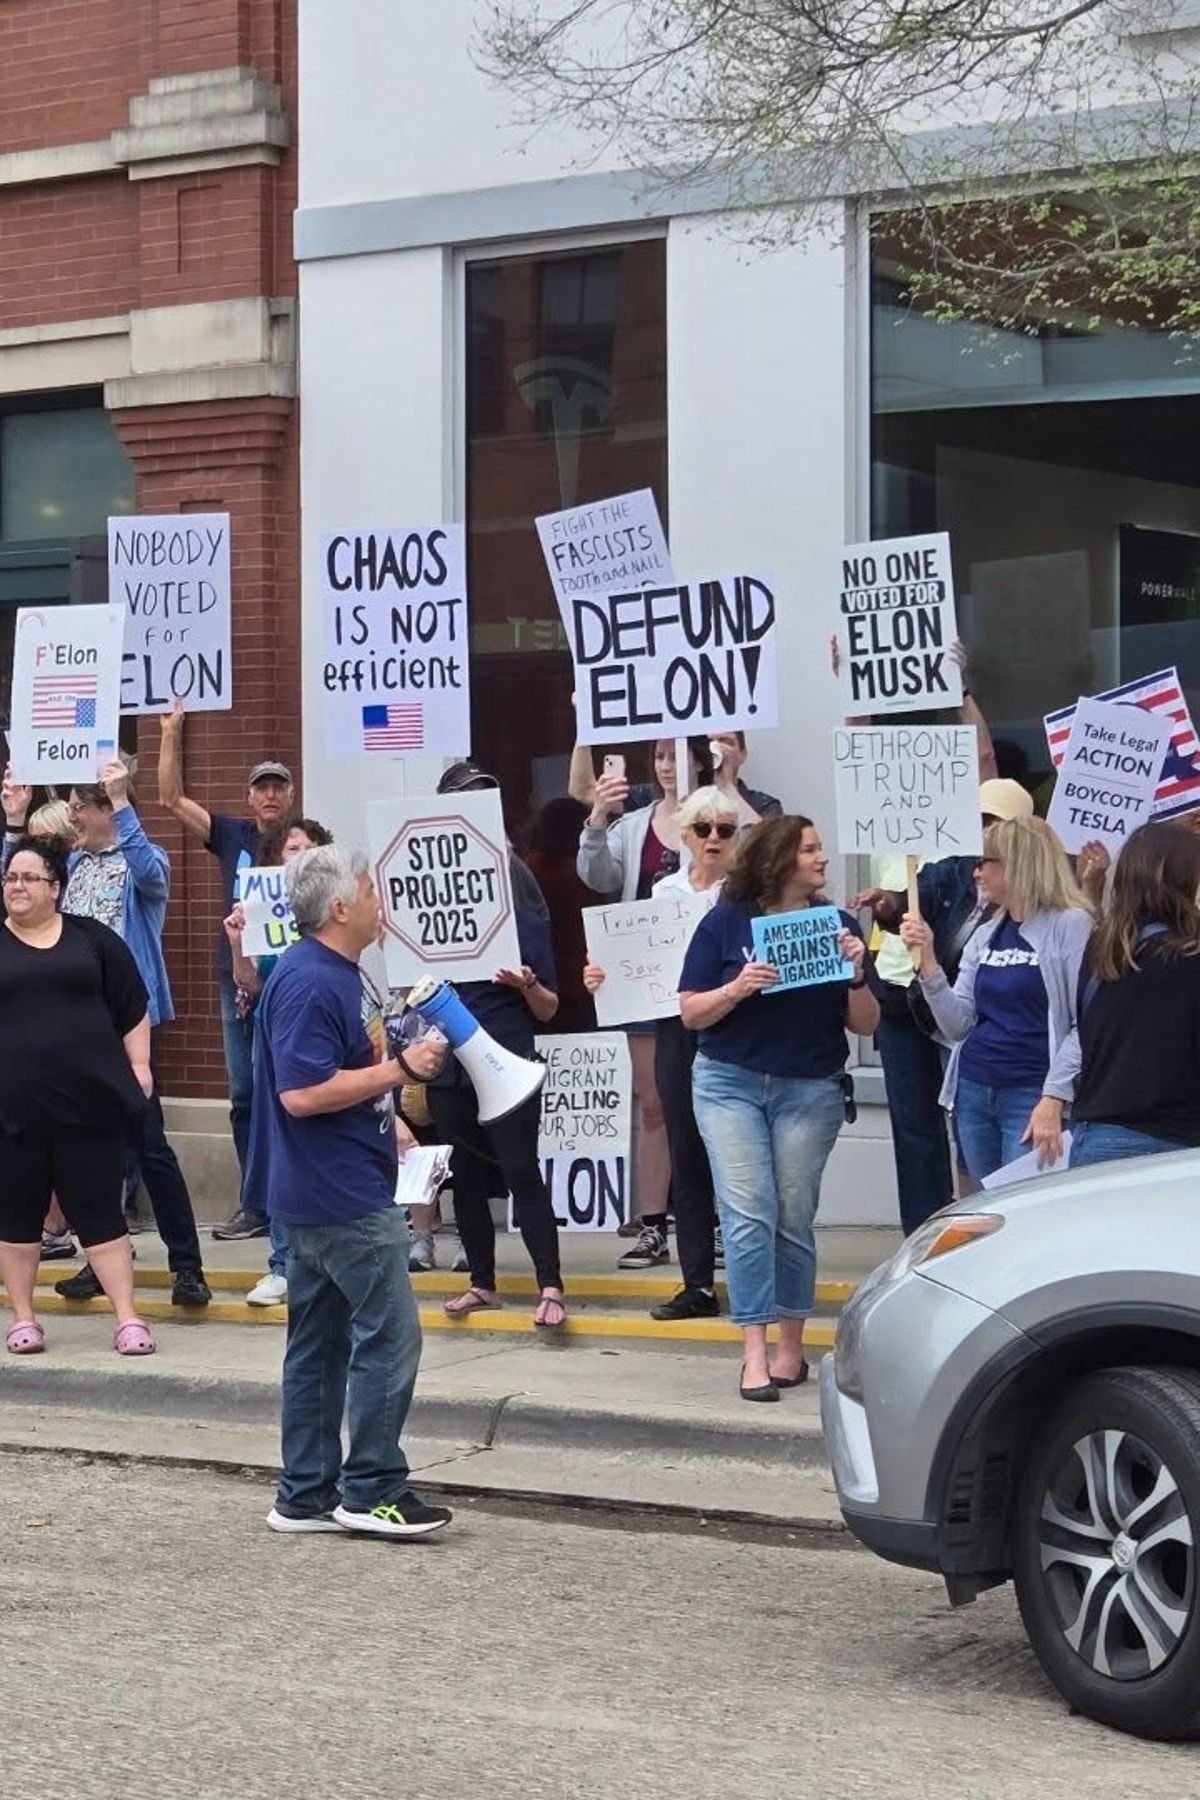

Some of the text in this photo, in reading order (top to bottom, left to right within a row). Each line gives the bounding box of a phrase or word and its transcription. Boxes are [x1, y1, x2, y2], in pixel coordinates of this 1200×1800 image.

[551, 501, 631, 540] FIGHT THE
[114, 528, 224, 567] NOBODY
[326, 529, 448, 592] CHAOS
[551, 524, 653, 572] FASCISTS
[842, 548, 939, 589] NO ONE
[124, 581, 218, 618] VOTED
[845, 583, 940, 613] VOTED FOR
[335, 598, 462, 645] IS NOT
[572, 576, 775, 665] DEFUND
[848, 606, 943, 657] ELON
[120, 649, 223, 709] ELON
[323, 649, 462, 692] efficient
[590, 645, 761, 729] ELON!
[850, 652, 949, 701] MUSK
[37, 739, 90, 761] Felon
[835, 730, 970, 760] DETHRONE
[1084, 723, 1159, 753] Take Legal
[842, 761, 969, 794] TRUMP
[1074, 746, 1154, 777] ACTION
[880, 794, 933, 810] AND
[1064, 782, 1144, 813] BOYCOTT
[855, 816, 961, 848] MUSK
[1069, 807, 1126, 836] TESLA
[408, 833, 468, 871] STOP
[389, 868, 496, 911] PROJECT
[417, 908, 478, 946] 2025
[597, 910, 660, 934] Trump
[763, 916, 838, 944] AMERICANS
[767, 933, 841, 967] AGAINST
[778, 957, 844, 985] IGARCHY
[570, 1046, 618, 1066] ONLY
[542, 1090, 620, 1114] EALING
[568, 1114, 619, 1138] JOBS
[538, 1156, 625, 1228] LON
